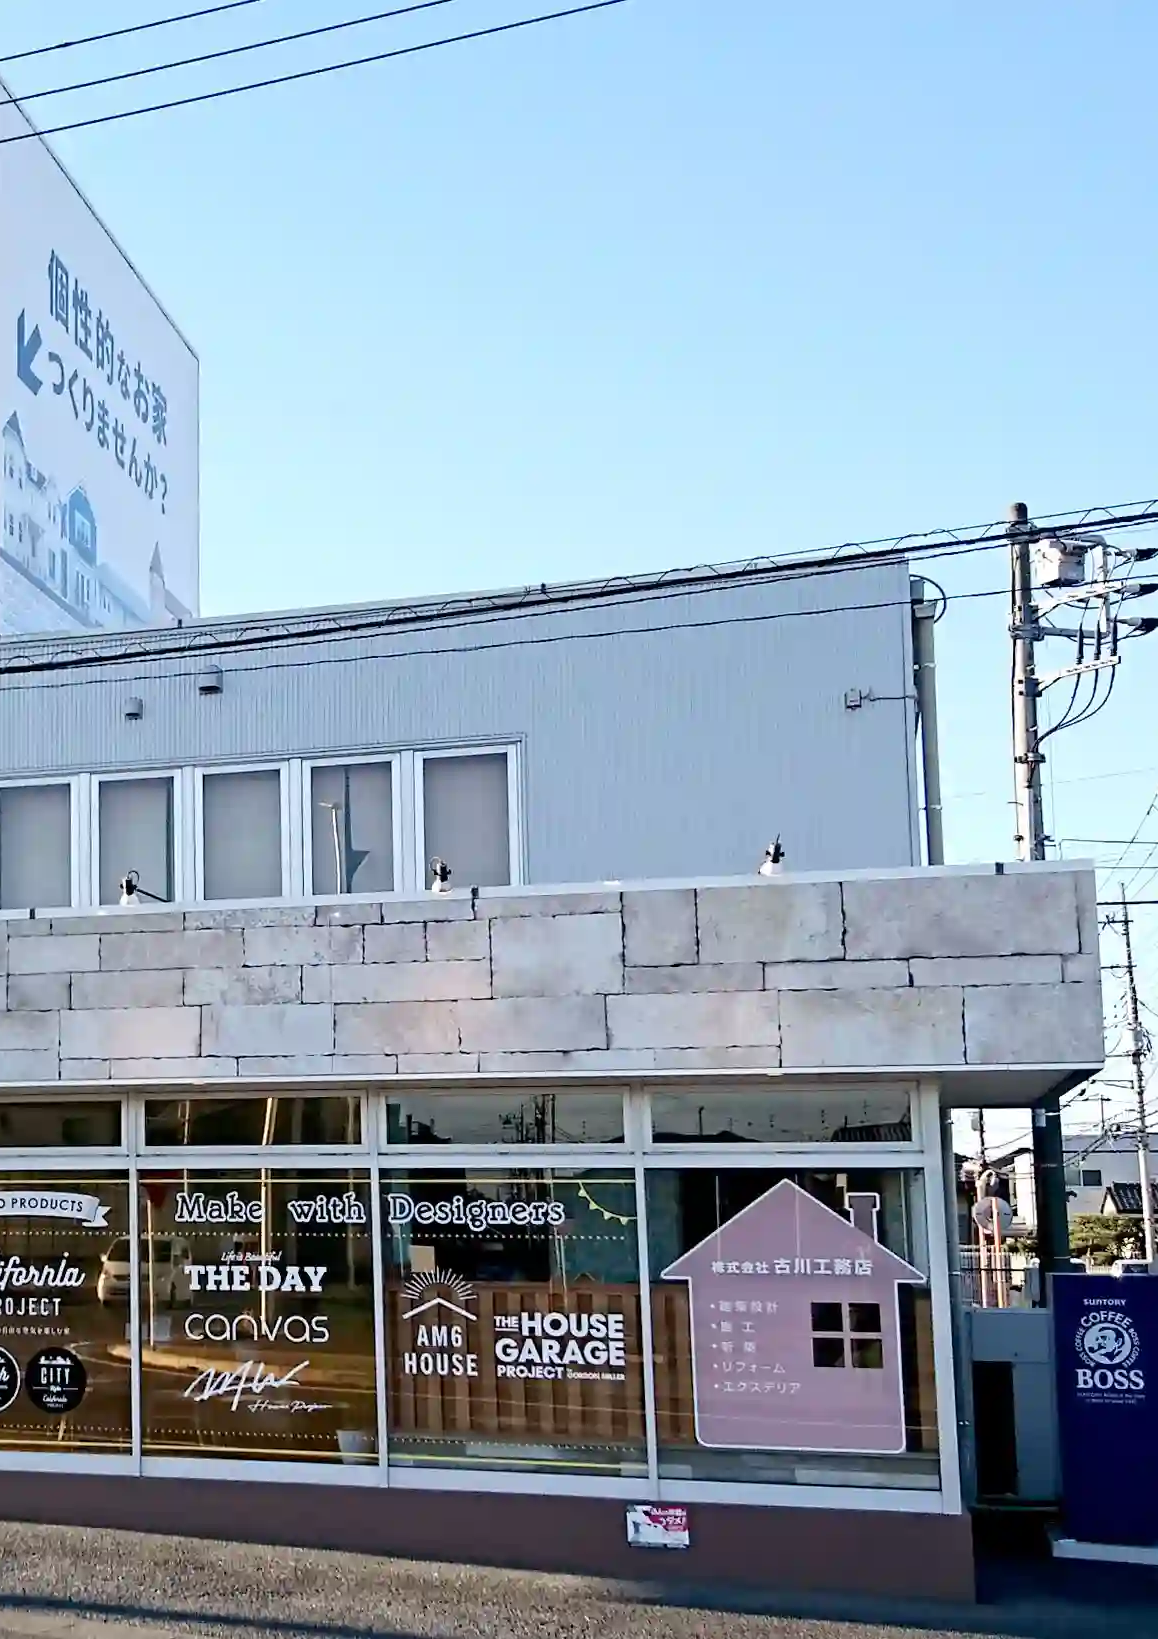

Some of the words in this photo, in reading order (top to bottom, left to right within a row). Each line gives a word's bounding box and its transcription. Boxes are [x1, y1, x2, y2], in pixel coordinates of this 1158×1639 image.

[47, 248, 168, 447] 個性的なお家
[11, 1198, 84, 1213] PRODUCTS
[174, 1192, 263, 1223] Make
[288, 1192, 366, 1224] with
[388, 1194, 565, 1232] Designers
[711, 1261, 770, 1275] 株式会社
[773, 1258, 874, 1276] 古川工務店
[184, 1265, 250, 1291] THE
[258, 1266, 327, 1292] DAY
[185, 1313, 330, 1343] canvas
[493, 1315, 519, 1328] THE
[521, 1312, 624, 1339] HOUSE
[1080, 1310, 1133, 1329] COFFEE
[495, 1337, 626, 1366] GARAGE
[404, 1352, 478, 1377] HOUSE
[496, 1365, 564, 1379] PROJECT
[722, 1360, 786, 1374] リフォーム
[41, 1367, 70, 1385] CITY
[1075, 1369, 1145, 1390] BOSS
[723, 1381, 801, 1394] エクステリア
